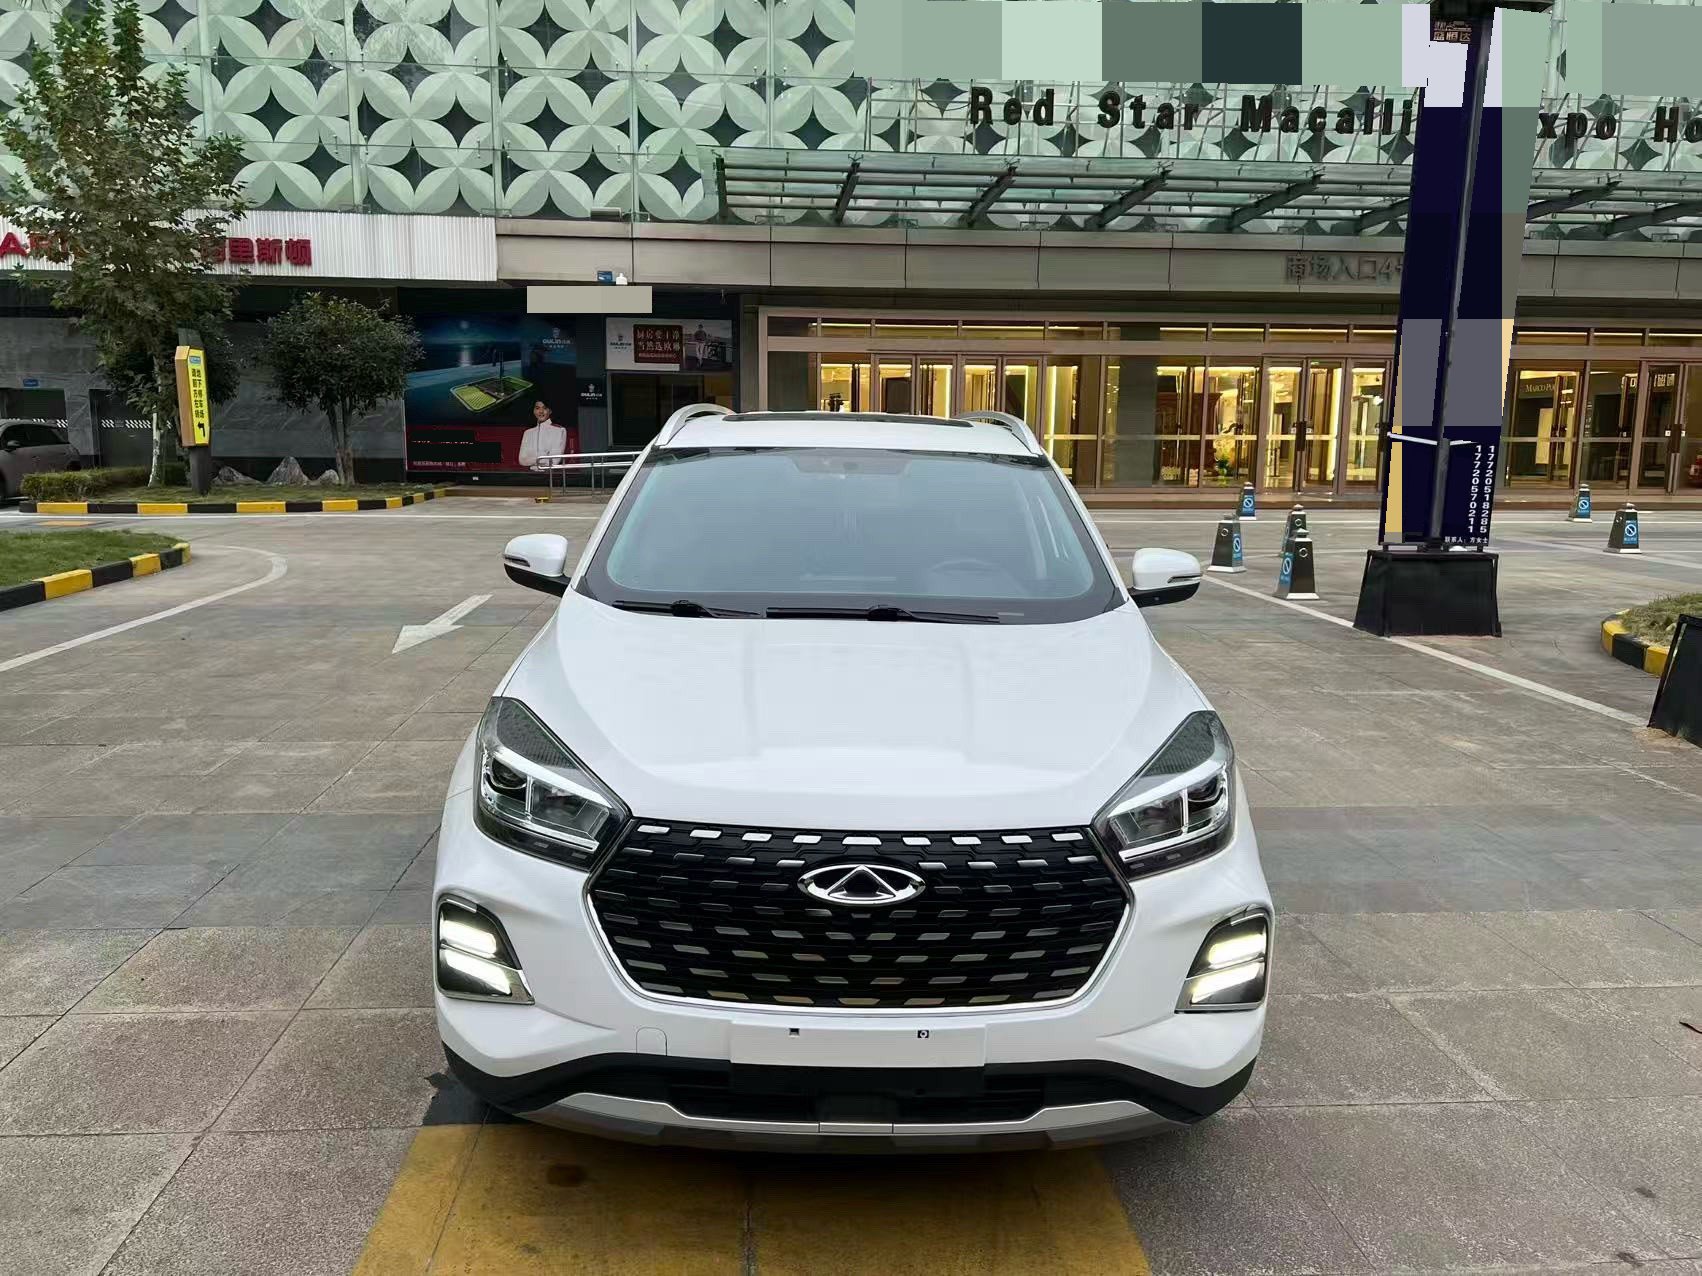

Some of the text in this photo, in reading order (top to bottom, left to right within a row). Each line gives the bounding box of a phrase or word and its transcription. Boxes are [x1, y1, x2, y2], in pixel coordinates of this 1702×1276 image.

[971, 86, 1702, 149] Red Star Macalli xpo Ho
[1468, 445, 1482, 533] 17720570211
[1480, 445, 1495, 533] 17720518285
